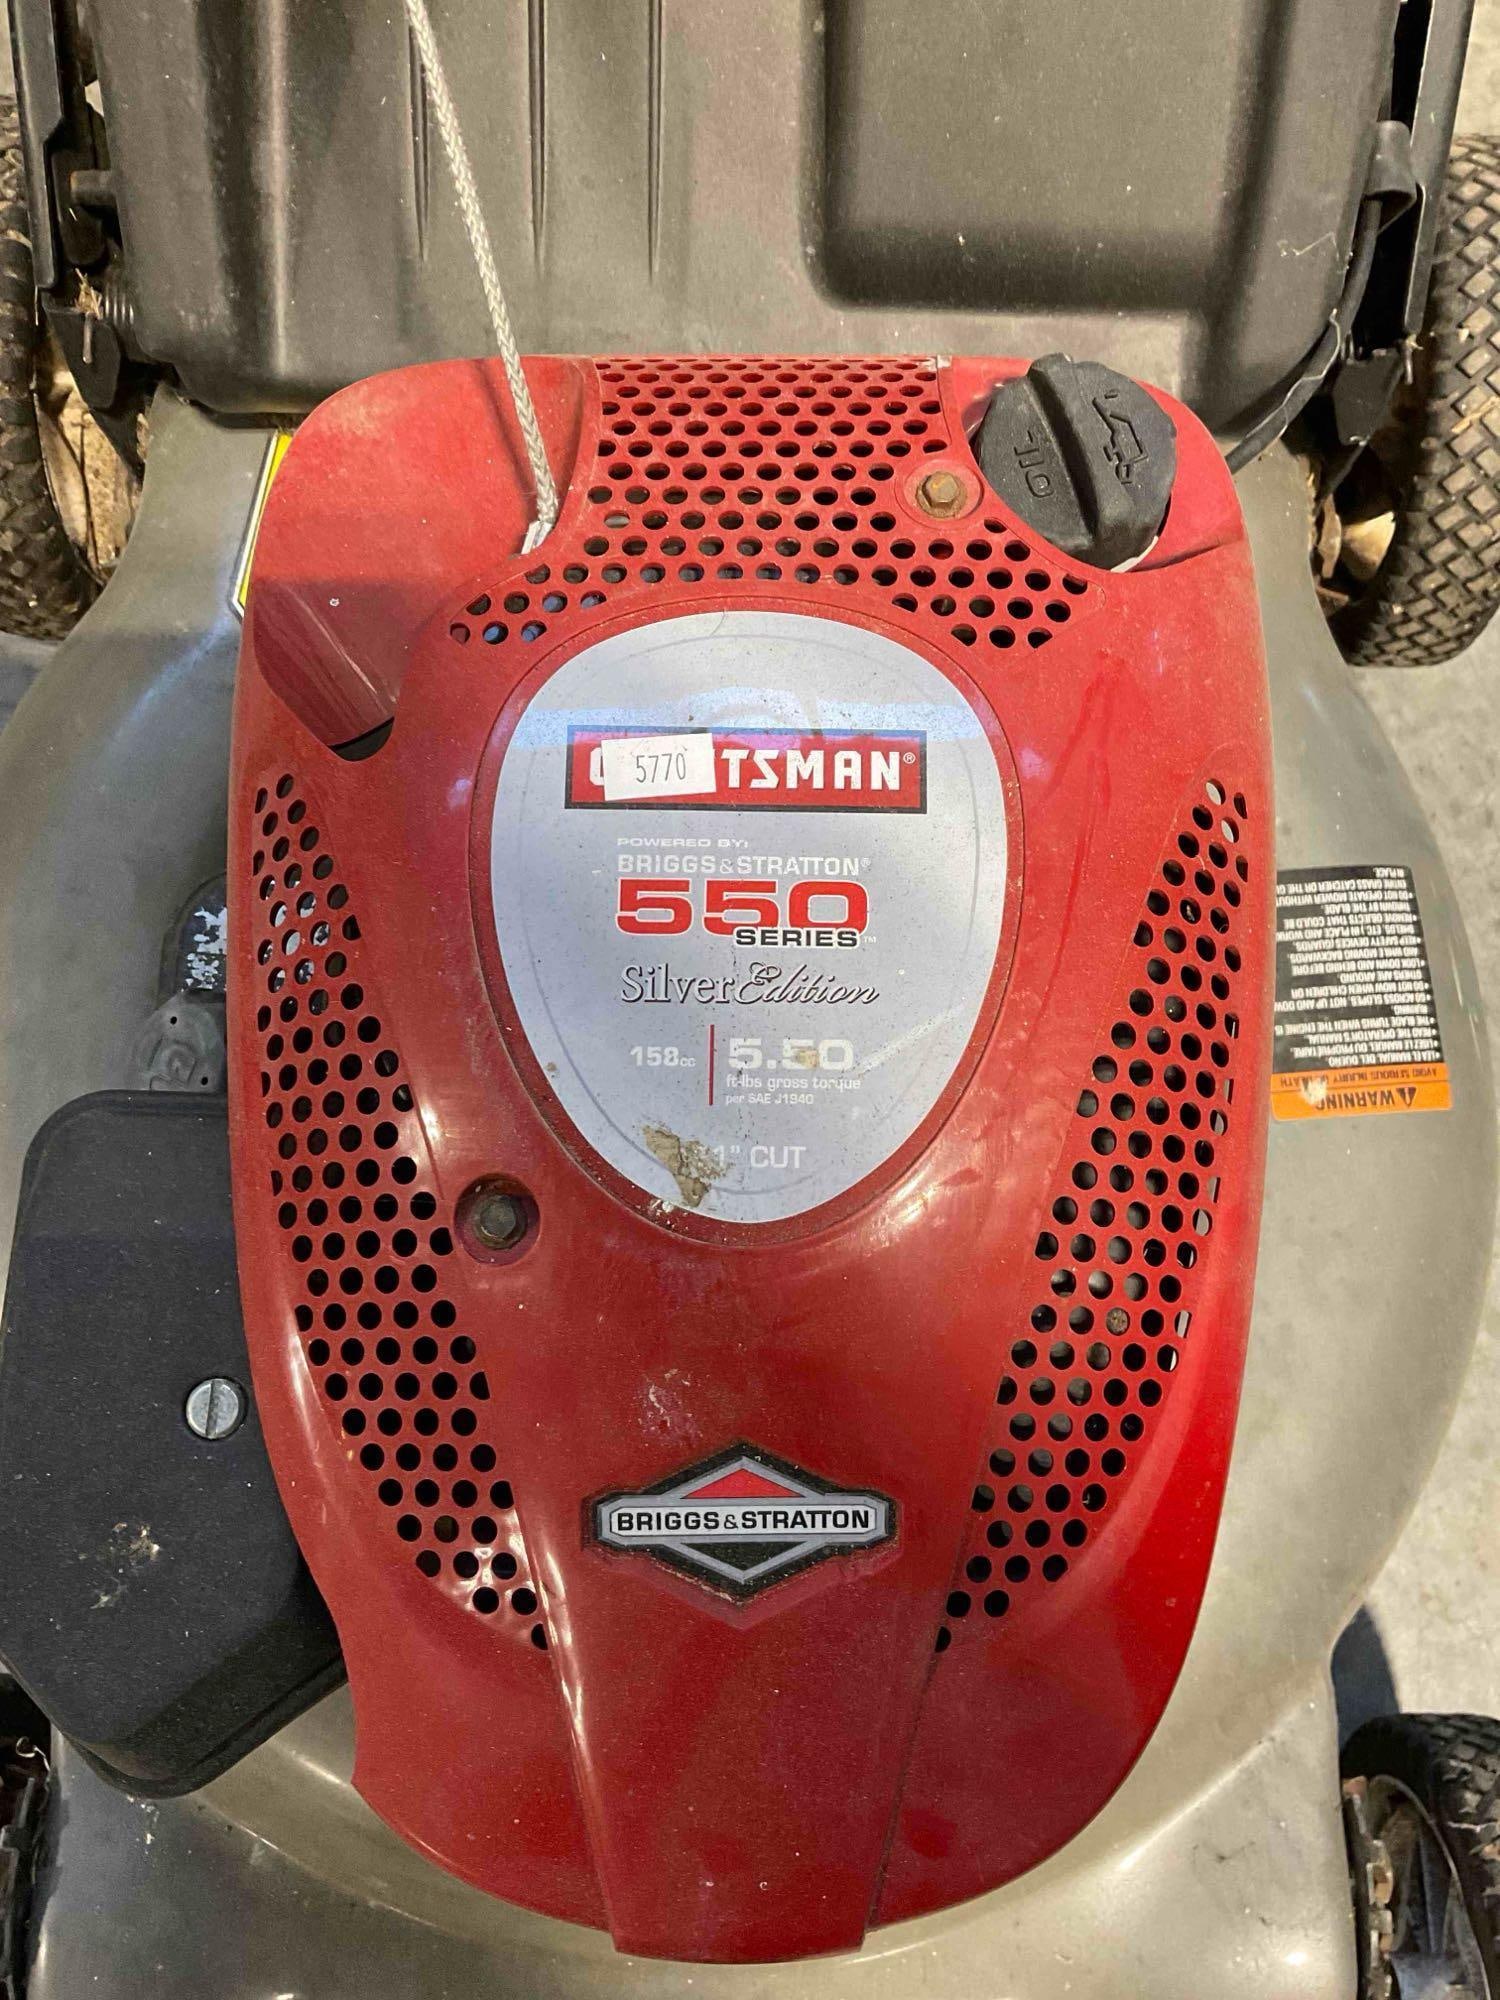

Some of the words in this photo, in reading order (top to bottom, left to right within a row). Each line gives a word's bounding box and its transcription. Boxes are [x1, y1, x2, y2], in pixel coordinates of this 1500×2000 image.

[1013, 430, 1054, 499] OIL
[636, 752, 687, 783] 5770
[617, 838, 711, 848] POWERED
[717, 838, 749, 849] BY:
[1287, 883, 1304, 894] THE
[1304, 882, 1317, 894] OR
[1318, 879, 1356, 892] CATCHER
[1356, 879, 1383, 890] GRASS
[1314, 892, 1348, 904] MOWER
[1349, 890, 1383, 902] OPERATE
[616, 877, 870, 937] 550
[1351, 903, 1368, 913] THE
[1368, 902, 1379, 912] BY
[1282, 918, 1296, 930] BE
[1296, 916, 1325, 929] COULD
[1327, 915, 1348, 926] THAT
[1349, 913, 1383, 925] OBJECTS
[734, 928, 860, 947] SERIES
[1304, 929, 1322, 940] AND
[1324, 927, 1350, 938] PLACE
[1335, 936, 1369, 948] DEVICES
[1370, 936, 1399, 947] SAFETY
[1344, 948, 1377, 960] MOVING
[1291, 963, 1324, 976] BEFORE
[1325, 960, 1356, 973] BEHIND
[1357, 959, 1375, 971] AND
[1376, 958, 1400, 970] DOWN
[1376, 971, 1393, 981] ARE
[1291, 988, 1305, 999] OR
[1306, 985, 1347, 998] CHILDREN
[1348, 983, 1374, 995] WHEN
[1296, 999, 1315, 1011] AND
[1316, 998, 1328, 1009] UP
[1330, 997, 1347, 1008] NOT
[1384, 993, 1414, 1005] ACROSS
[1317, 1022, 1333, 1033] THE
[1334, 1019, 1360, 1031] WHEN
[630, 1045, 697, 1068] 158cc
[728, 1037, 854, 1071] 5.50
[767, 1076, 809, 1092] gross
[812, 1074, 862, 1093] torque
[725, 1094, 745, 1106] per
[748, 1092, 771, 1104] SAE
[774, 1093, 815, 1105] J1940
[750, 1145, 807, 1169] CUT
